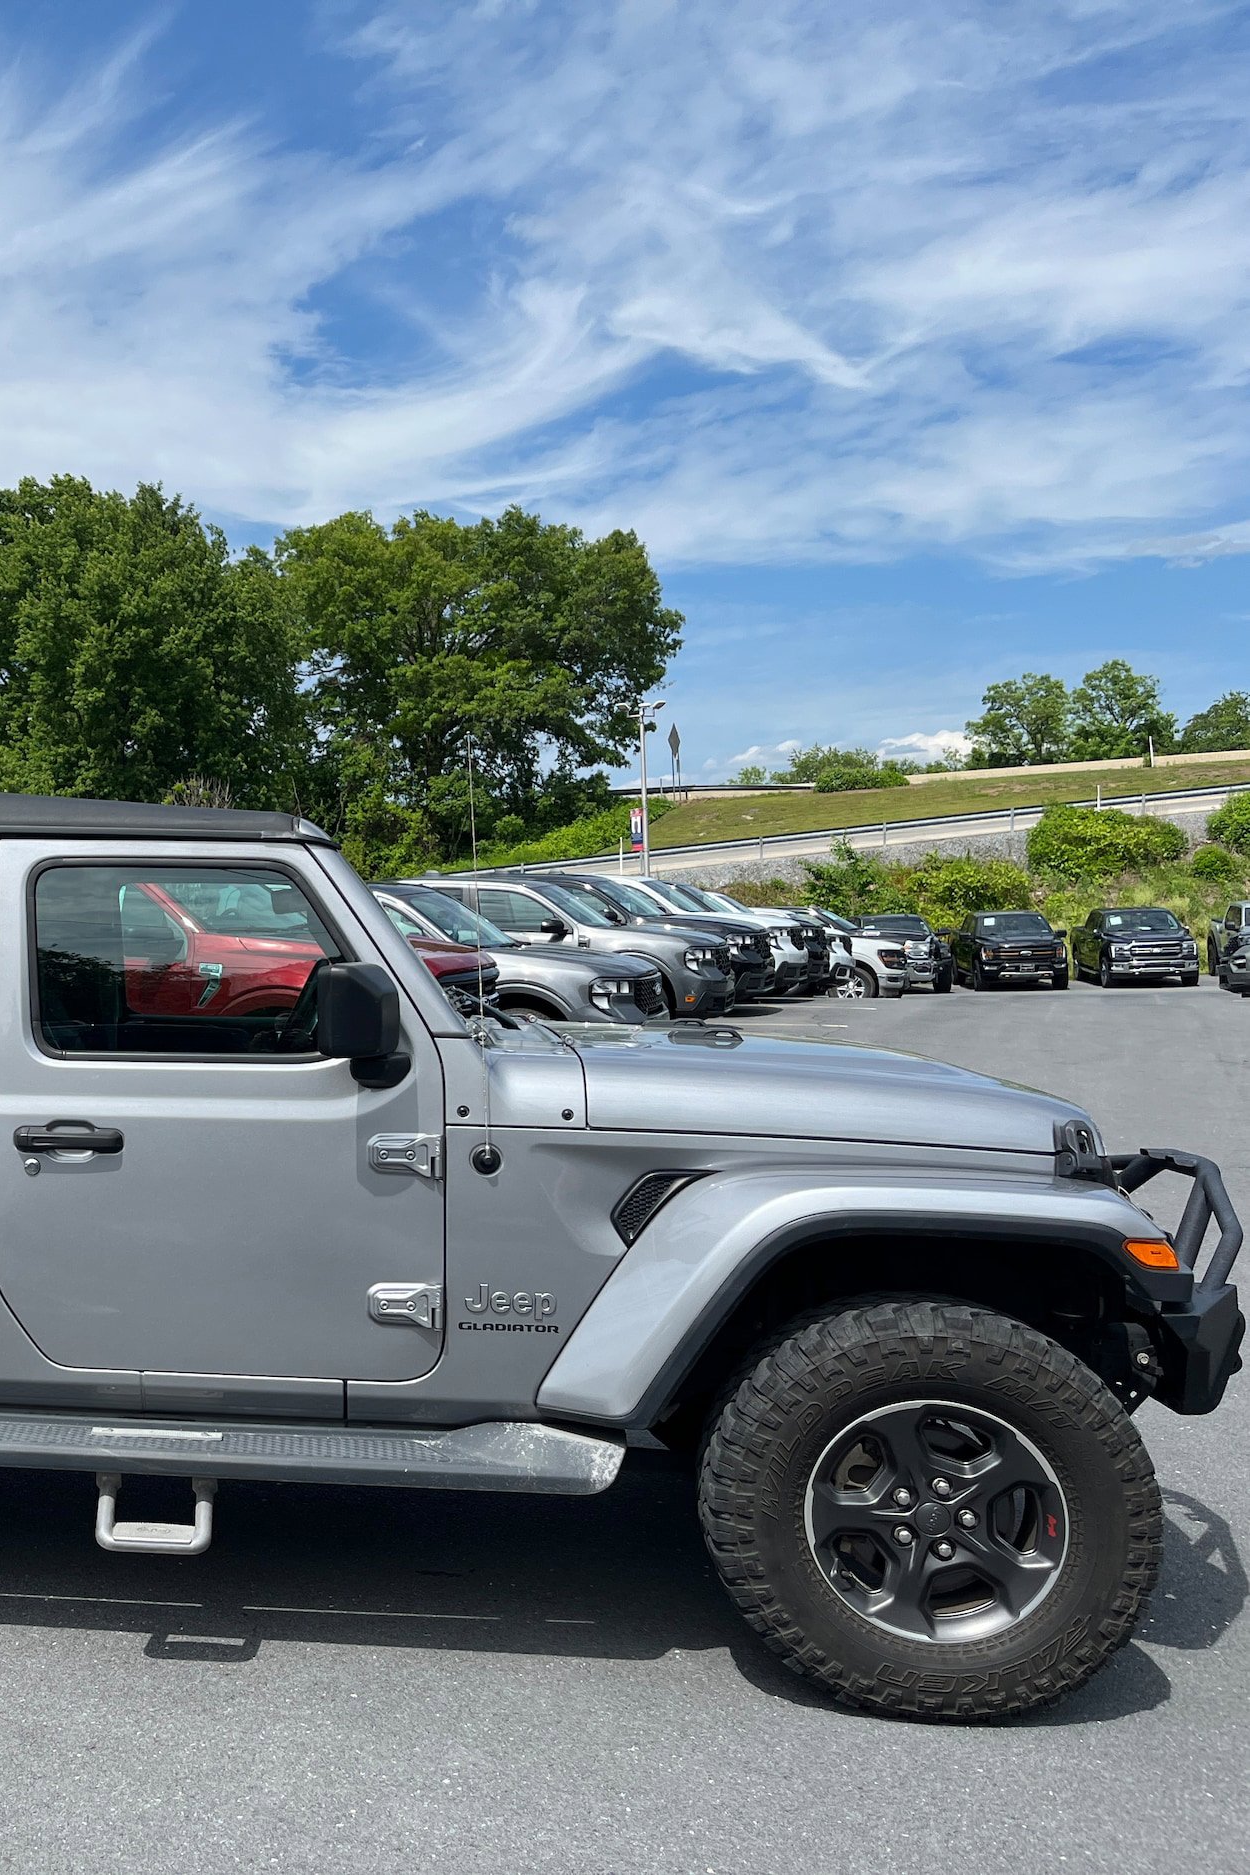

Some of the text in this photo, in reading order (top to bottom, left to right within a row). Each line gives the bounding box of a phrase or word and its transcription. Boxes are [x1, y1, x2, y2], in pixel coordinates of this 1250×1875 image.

[458, 1322, 559, 1334] GLADIATOR
[464, 1283, 558, 1321] Jeep
[761, 1359, 965, 1520] WILDPEAK
[983, 1374, 1083, 1430] M/T
[875, 1614, 1091, 1693] FALKEN
